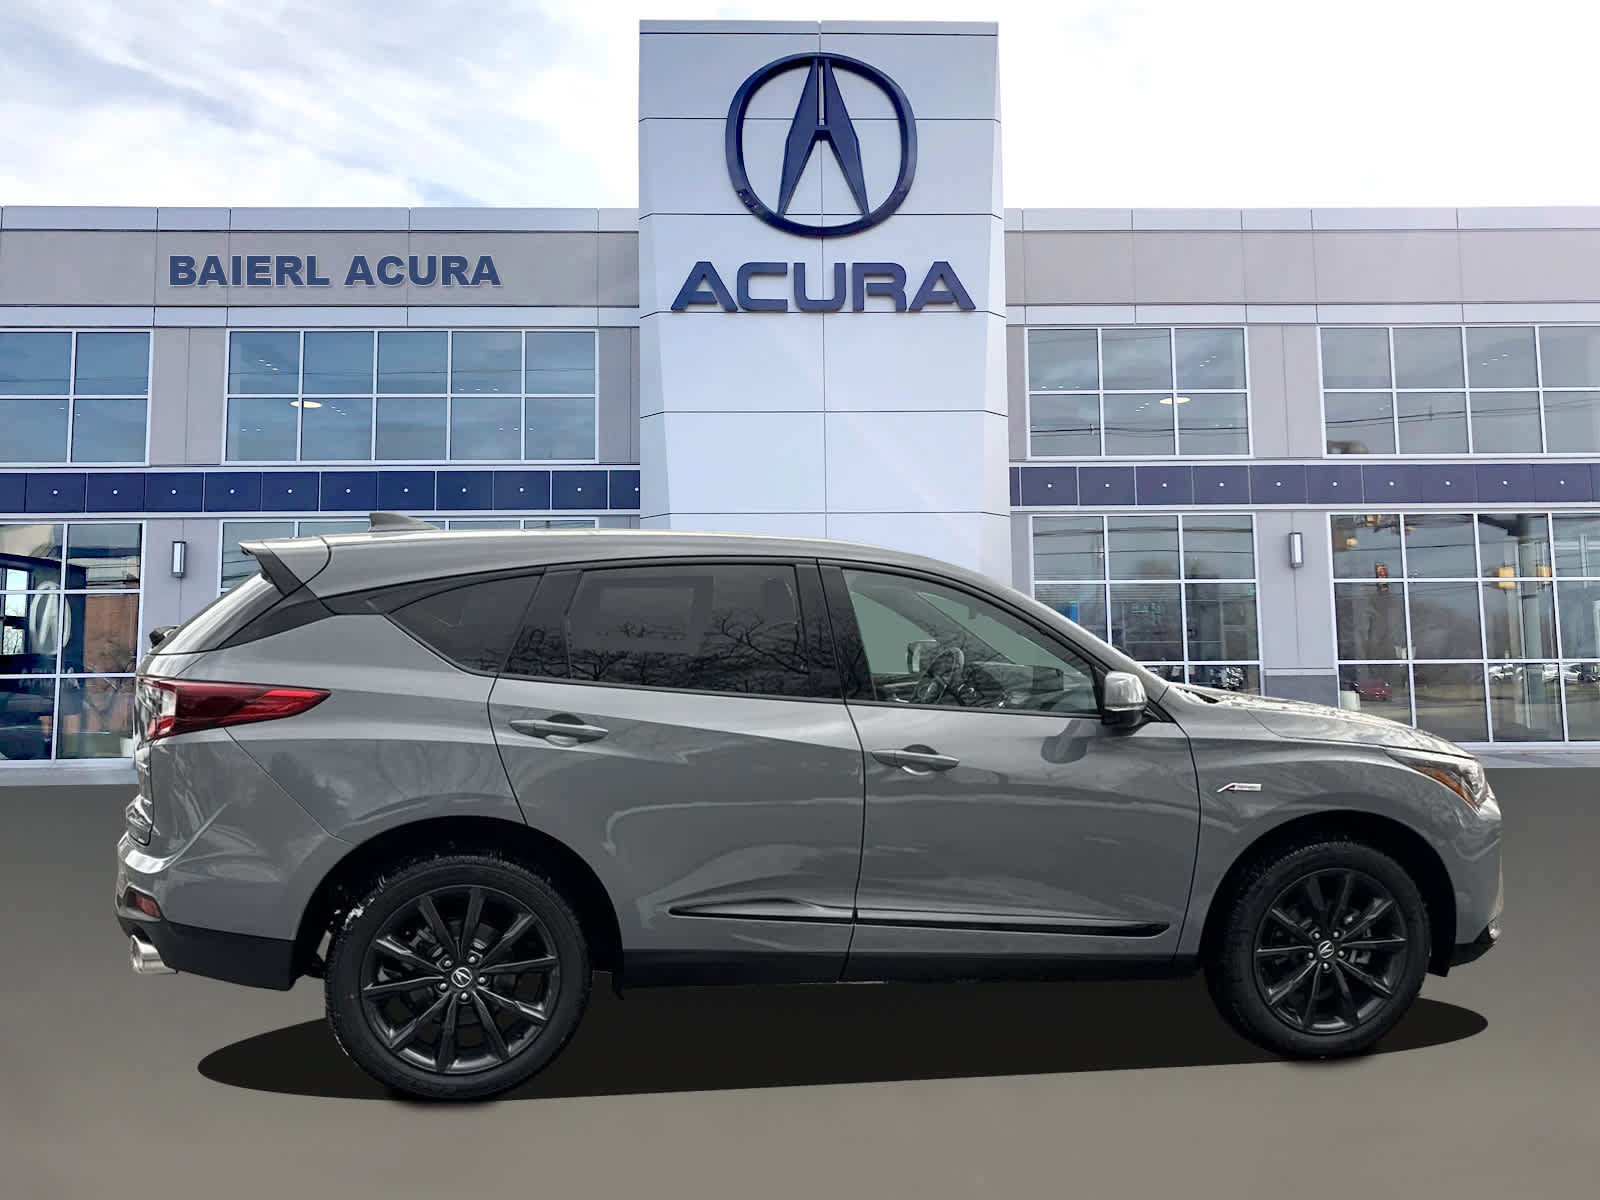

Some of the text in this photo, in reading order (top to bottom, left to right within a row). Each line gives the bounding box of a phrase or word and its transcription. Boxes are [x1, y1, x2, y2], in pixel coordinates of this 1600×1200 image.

[168, 255, 503, 287] BAIERL ACURA
[670, 261, 977, 313] ACURA
